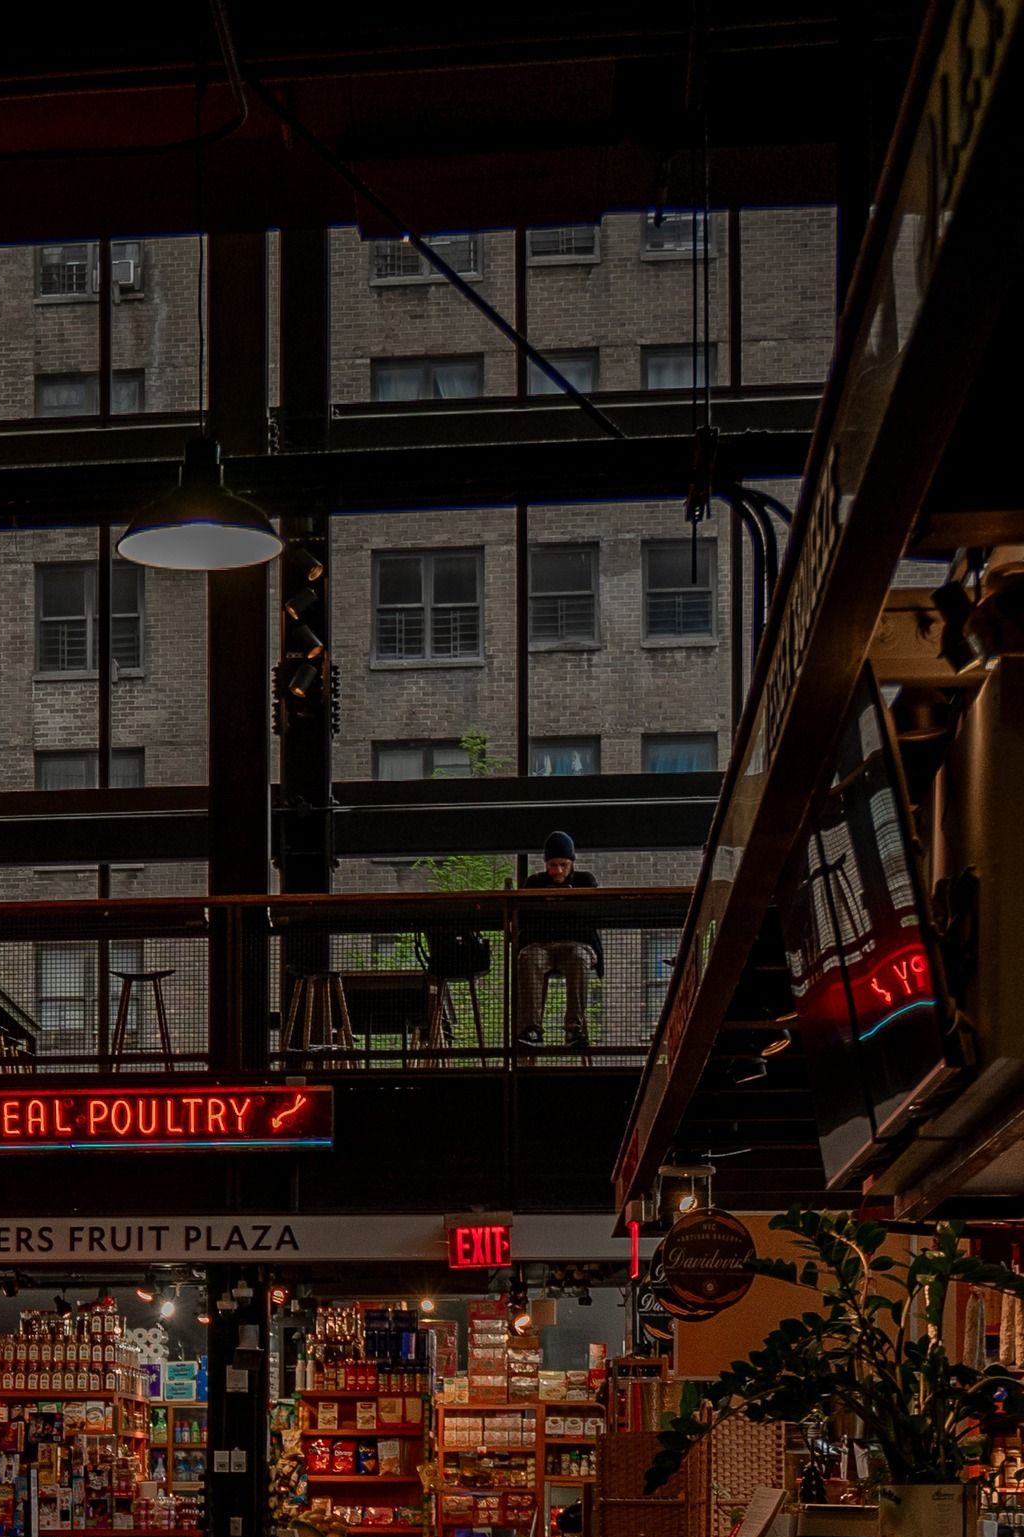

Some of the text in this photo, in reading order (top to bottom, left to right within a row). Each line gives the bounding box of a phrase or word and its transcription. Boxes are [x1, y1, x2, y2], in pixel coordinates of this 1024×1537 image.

[88, 1097, 252, 1136] POULTRY
[69, 1225, 170, 1252] FRUIT
[184, 1225, 300, 1252] PLAZA
[456, 1226, 505, 1265] EXIT
